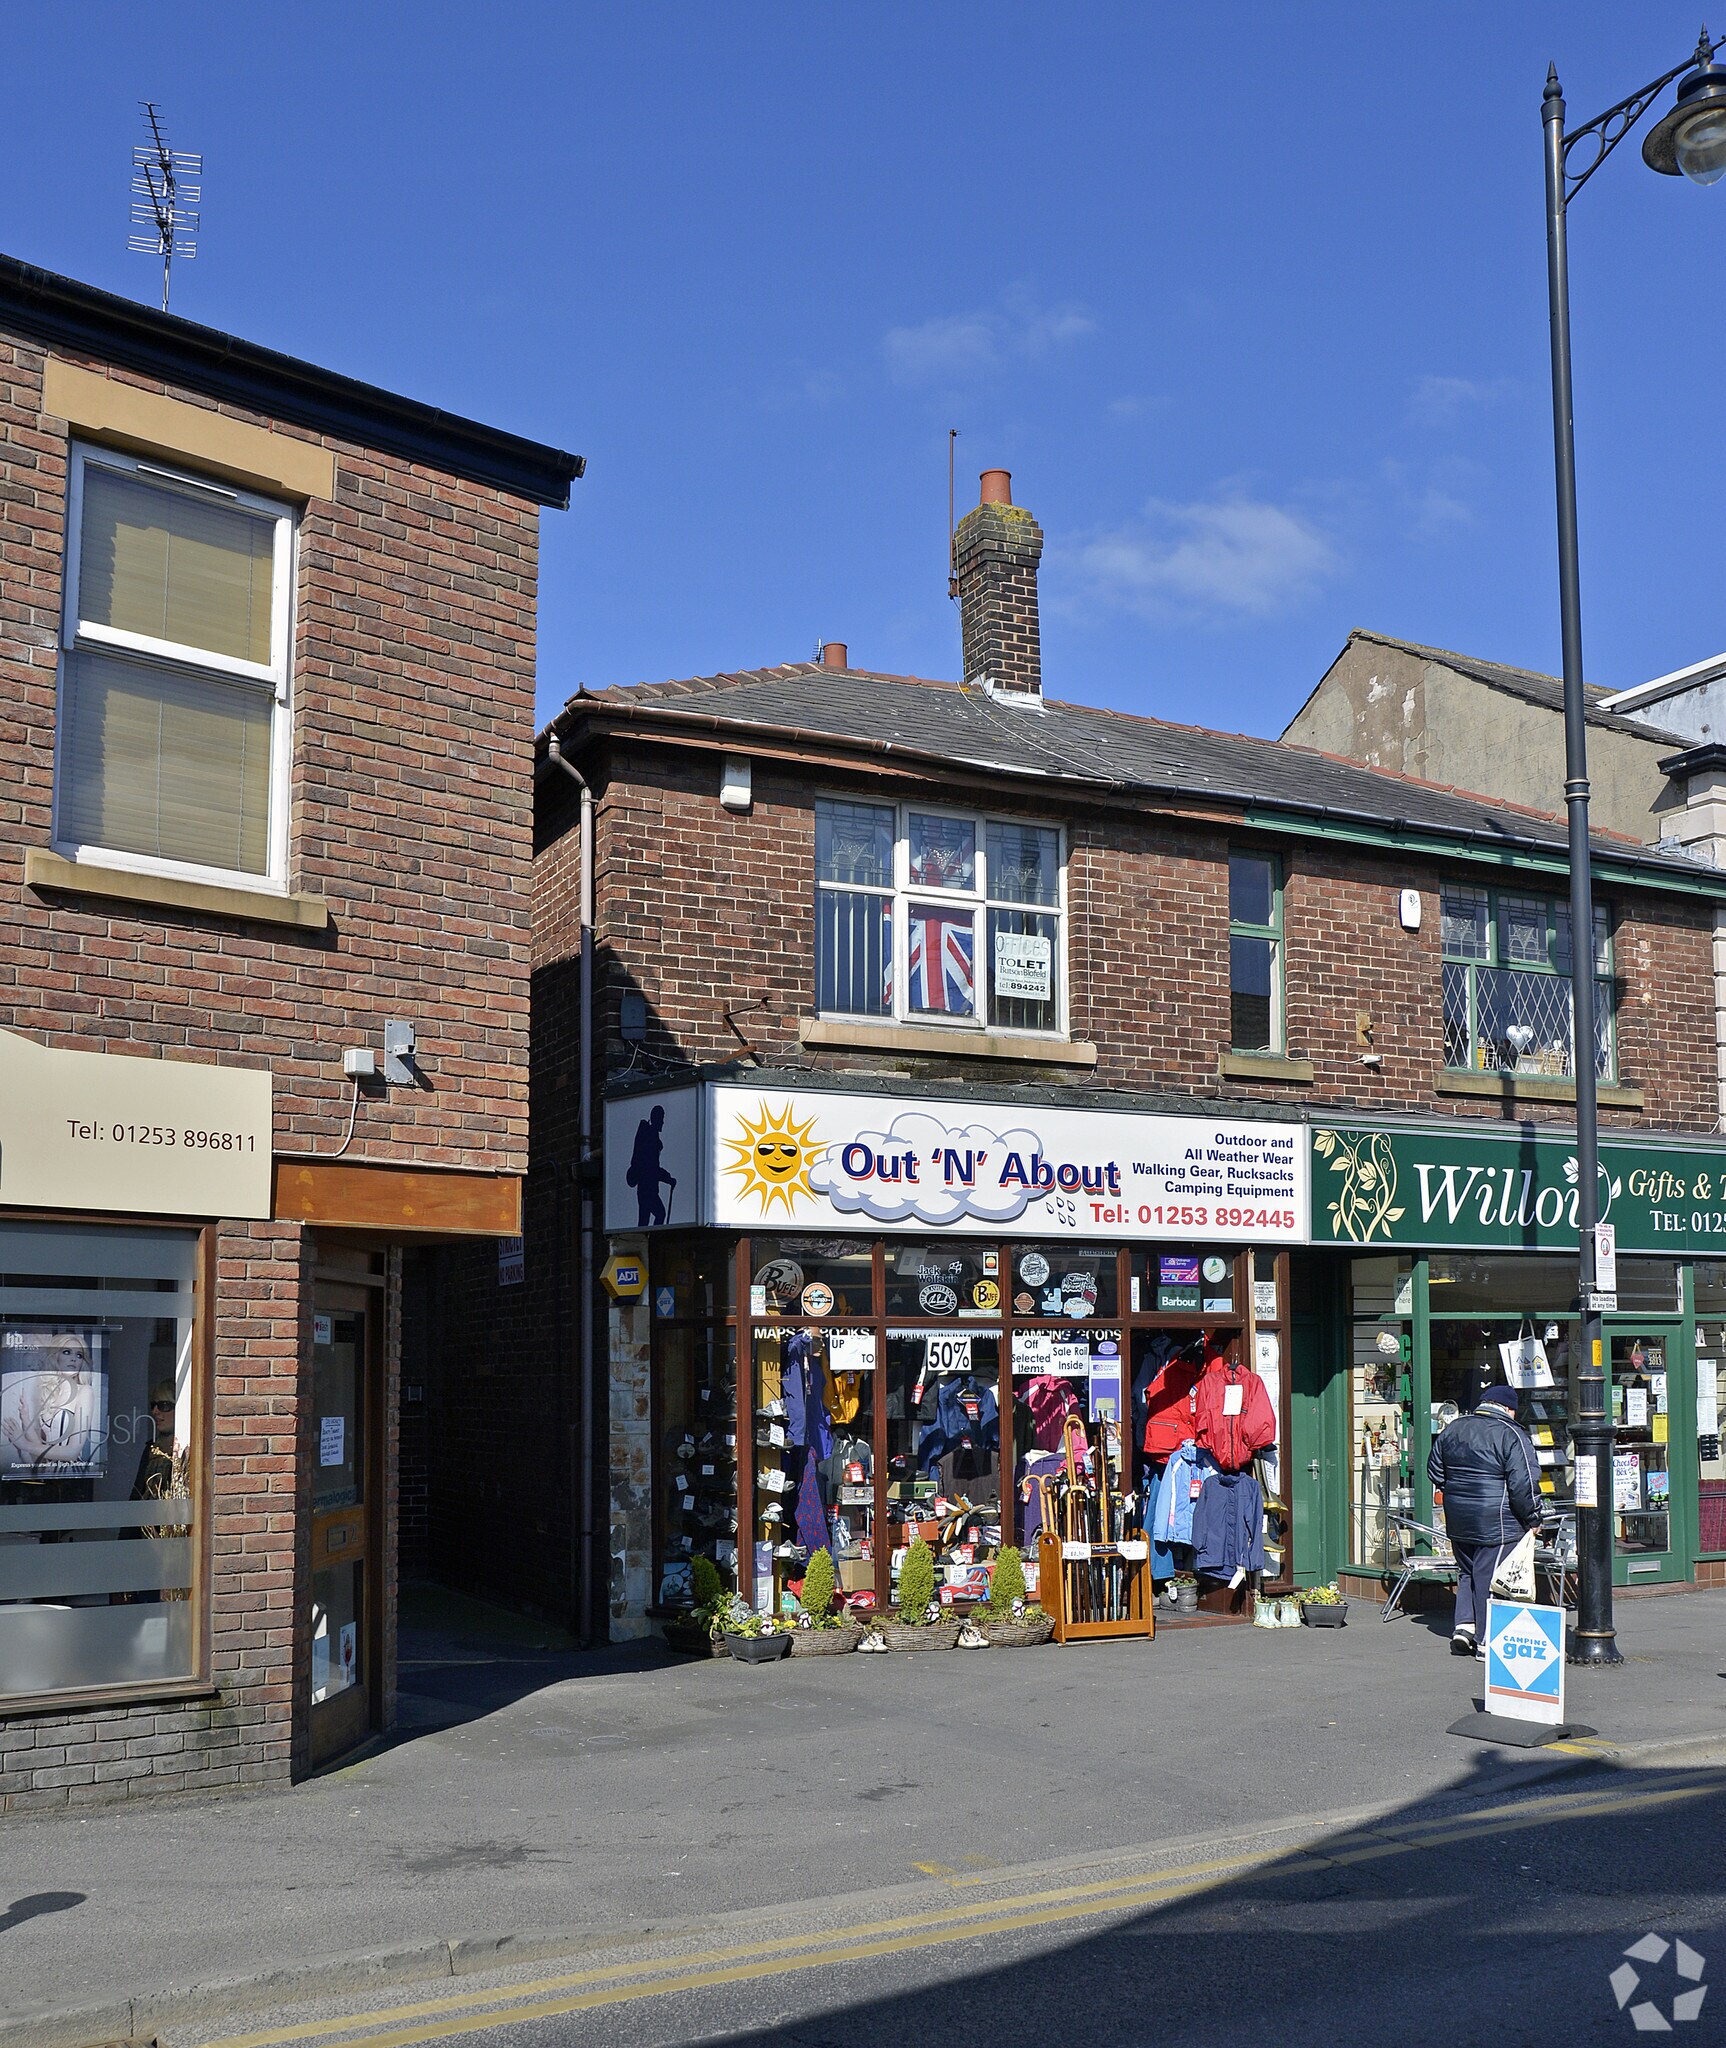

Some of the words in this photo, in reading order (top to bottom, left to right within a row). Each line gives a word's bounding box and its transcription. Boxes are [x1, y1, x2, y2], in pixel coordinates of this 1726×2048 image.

[1011, 982, 1046, 992] 894242
[67, 1120, 104, 1140] Tel:
[112, 1124, 176, 1146] 01253
[183, 1130, 255, 1151] 896811
[1215, 1133, 1267, 1147] Outdoor
[1271, 1137, 1293, 1148] and
[1185, 1149, 1202, 1160] All
[1207, 1149, 1259, 1163] Weather
[1263, 1153, 1294, 1164] Wear
[841, 1143, 919, 1183] Out
[999, 1152, 1121, 1195] About
[1132, 1162, 1186, 1178] Walking
[1190, 1165, 1223, 1179] Gear,
[1228, 1167, 1294, 1181] Rucksacks
[1165, 1181, 1223, 1197] Camping
[1227, 1184, 1294, 1198] Equipment
[1628, 1168, 1685, 1203] Gifts
[1692, 1170, 1712, 1200] &
[1090, 1203, 1129, 1223] Tel:
[1138, 1205, 1207, 1225] 01253
[1215, 1207, 1295, 1228] 892445
[617, 1270, 639, 1282] ADT
[917, 1265, 941, 1275] Jack
[917, 1274, 958, 1283] Wolfskin
[1162, 1296, 1197, 1307] Barbour
[754, 1327, 796, 1339] MAPS
[832, 1339, 845, 1348] UP
[1024, 1340, 1039, 1349] Off
[929, 1341, 970, 1369] 50%
[1053, 1347, 1072, 1356] Sale
[1074, 1346, 1088, 1356] Rail
[862, 1354, 875, 1363] TO
[1012, 1354, 1051, 1363] Selected
[1018, 1364, 1045, 1373] Items
[1058, 1360, 1084, 1370] Inside
[1400, 1333, 1412, 1478] CAFE
[1503, 1635, 1547, 1646] CAMPING
[1503, 1643, 1546, 1660] gaz
